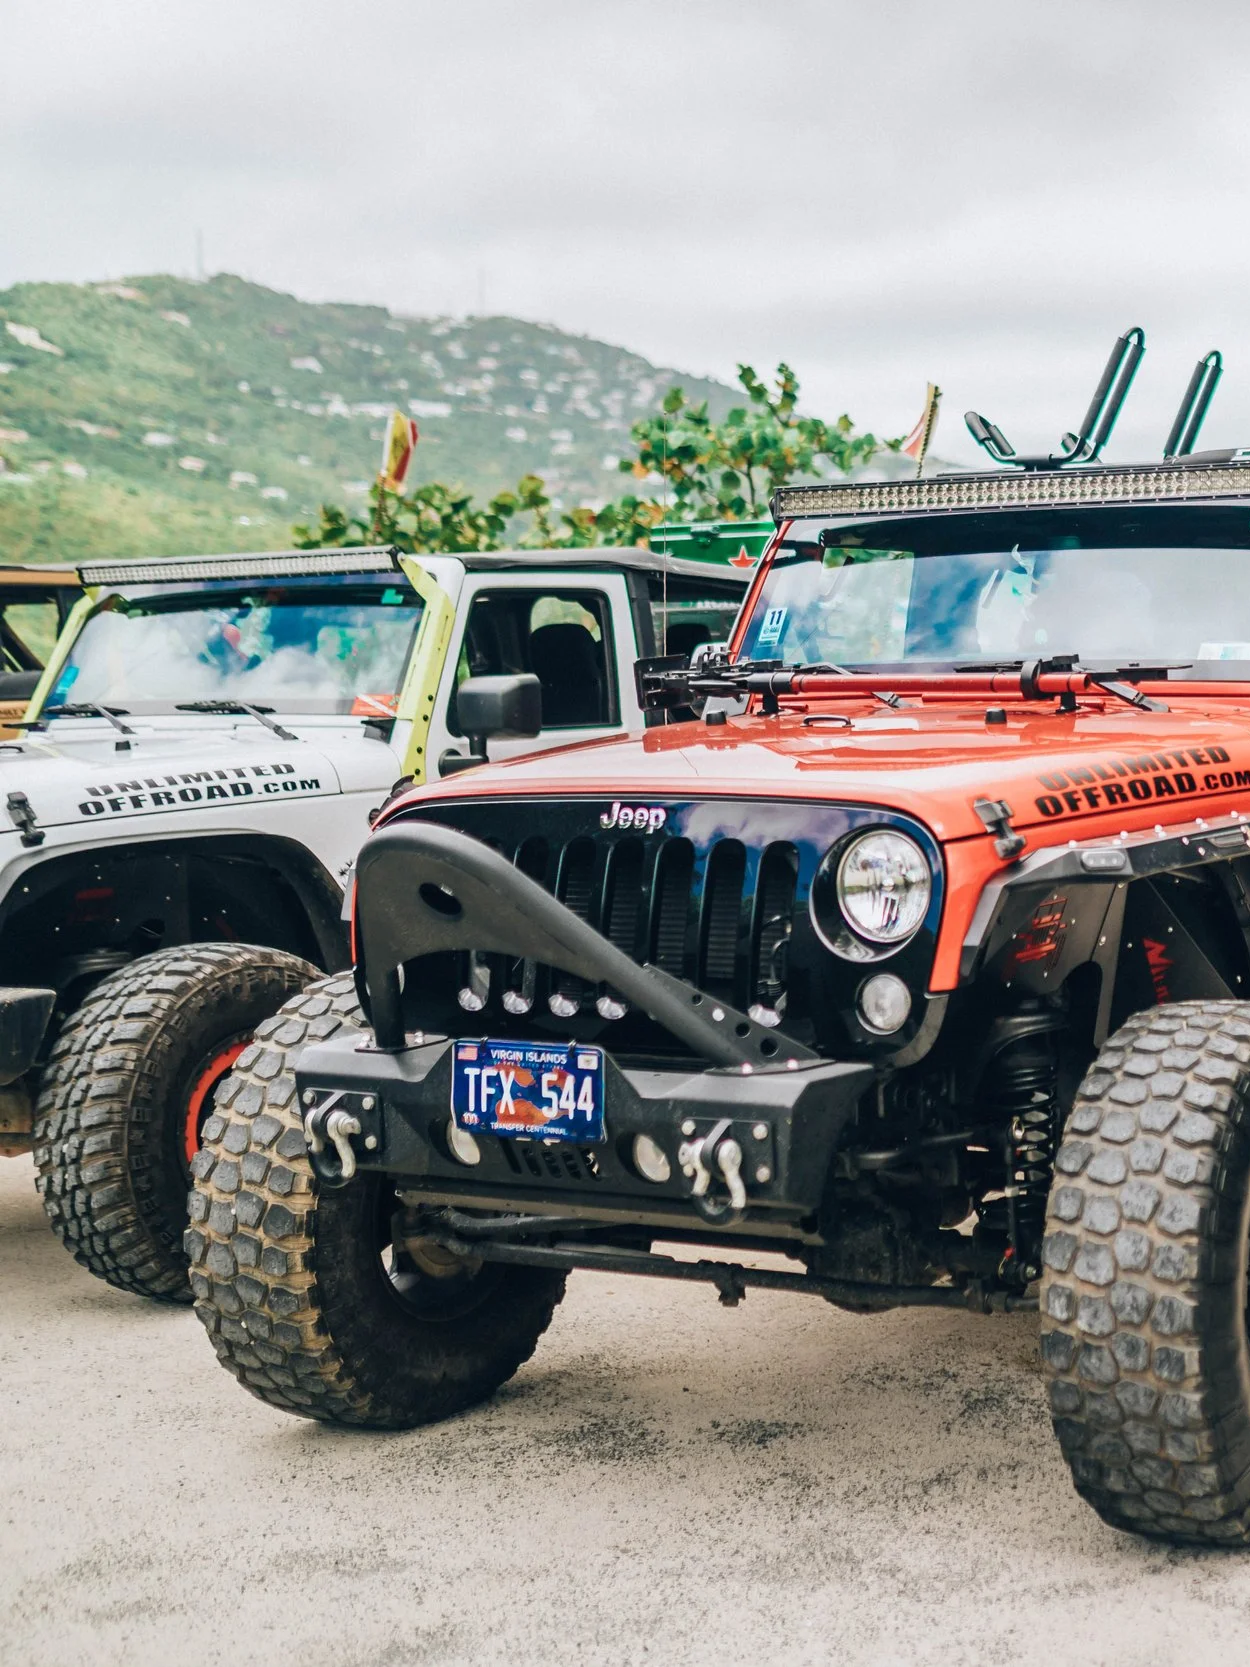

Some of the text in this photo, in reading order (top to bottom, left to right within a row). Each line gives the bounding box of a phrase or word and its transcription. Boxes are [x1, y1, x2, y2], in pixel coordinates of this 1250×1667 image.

[770, 610, 783, 625] 11
[84, 763, 296, 797] UNLIMITED
[1036, 746, 1231, 791] UNLIMITED
[78, 779, 321, 816] OFFROAD.COM
[600, 801, 667, 834] Jeep
[490, 1049, 567, 1065] VIRGIN ISLANDS
[464, 1067, 594, 1122] TFX 544
[490, 1121, 568, 1136] TRANSFER CENTENNIAL
